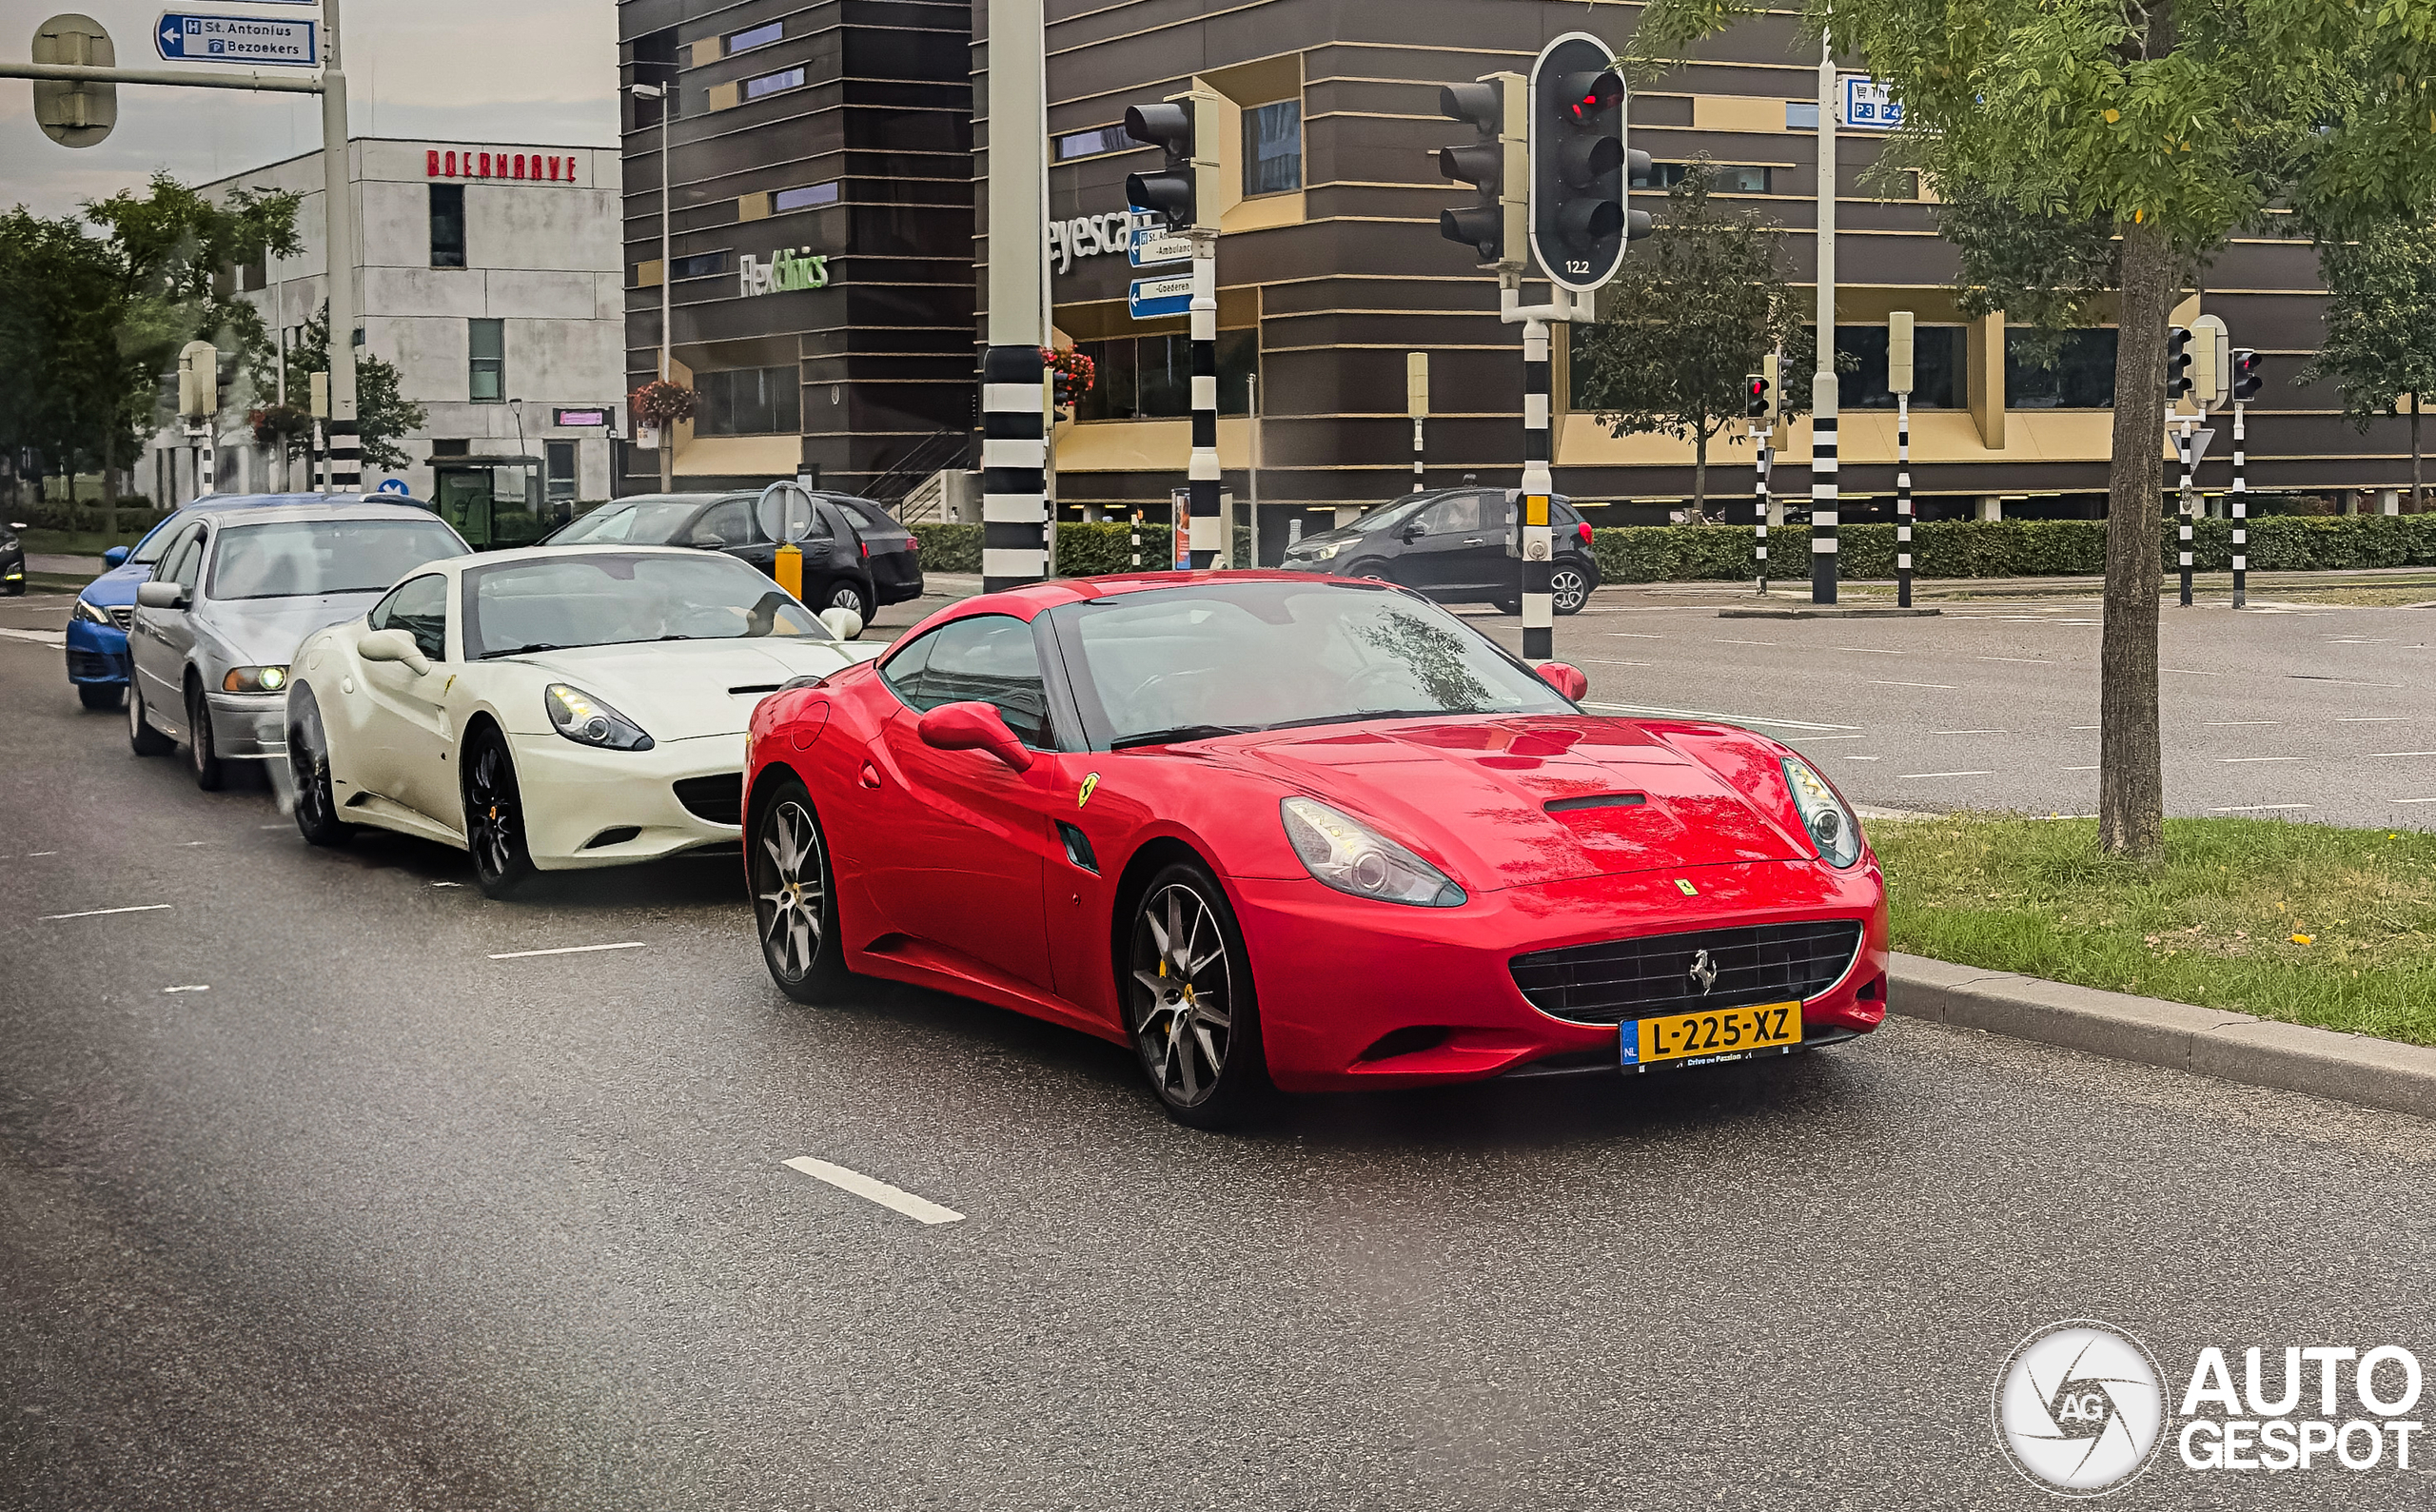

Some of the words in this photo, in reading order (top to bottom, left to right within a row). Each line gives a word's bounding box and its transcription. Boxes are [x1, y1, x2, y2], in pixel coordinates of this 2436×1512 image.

[205, 22, 225, 33] St.
[227, 23, 291, 36] Antonius
[227, 41, 300, 55] Bezoekers
[1872, 87, 1889, 98] Th
[1856, 105, 1873, 117] P3
[1883, 106, 1900, 119] P4
[426, 150, 576, 183] BOERHAAVE
[1565, 260, 1590, 274] 122
[1624, 1047, 1638, 1058] NL
[1653, 1008, 1790, 1055] L-225-XZ
[1716, 1053, 1741, 1063] Passion
